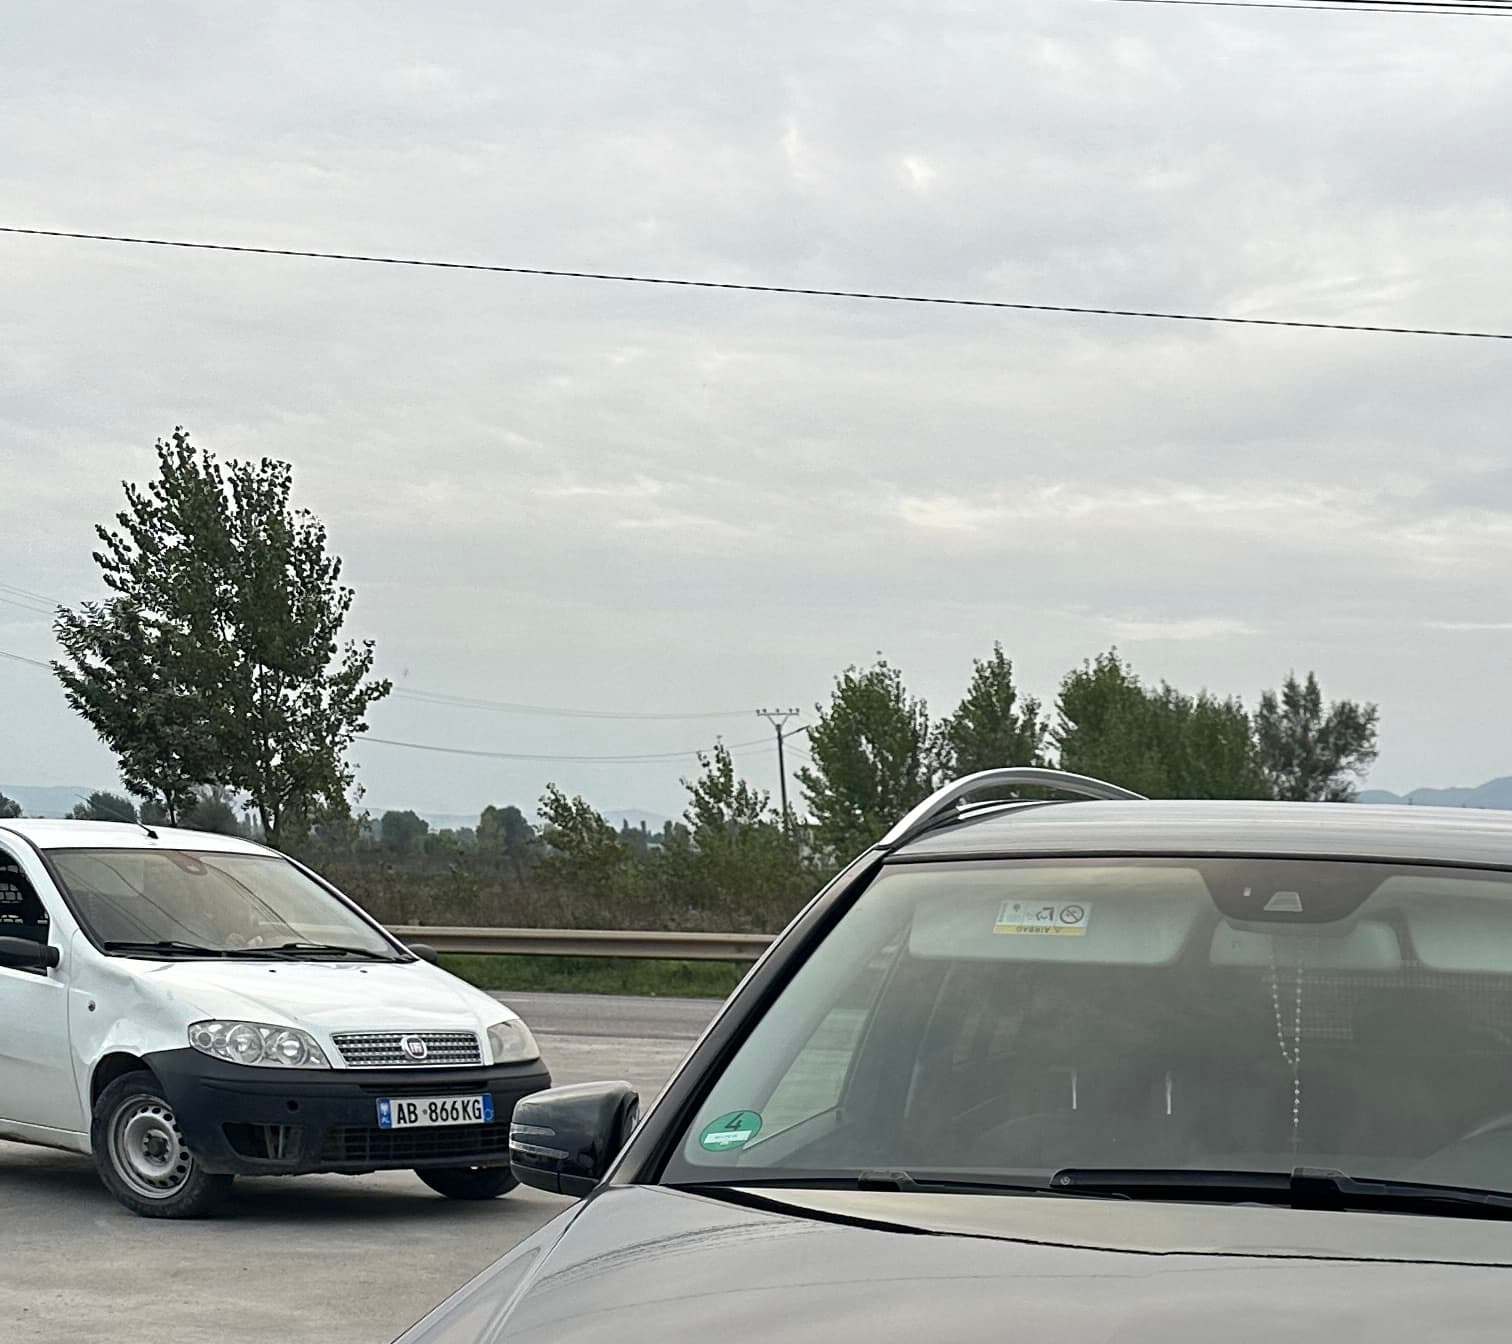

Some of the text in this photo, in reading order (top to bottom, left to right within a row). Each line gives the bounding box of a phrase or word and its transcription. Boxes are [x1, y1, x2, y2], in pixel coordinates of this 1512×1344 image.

[397, 1099, 482, 1124] AB 866KG
[724, 1112, 744, 1131] 4
